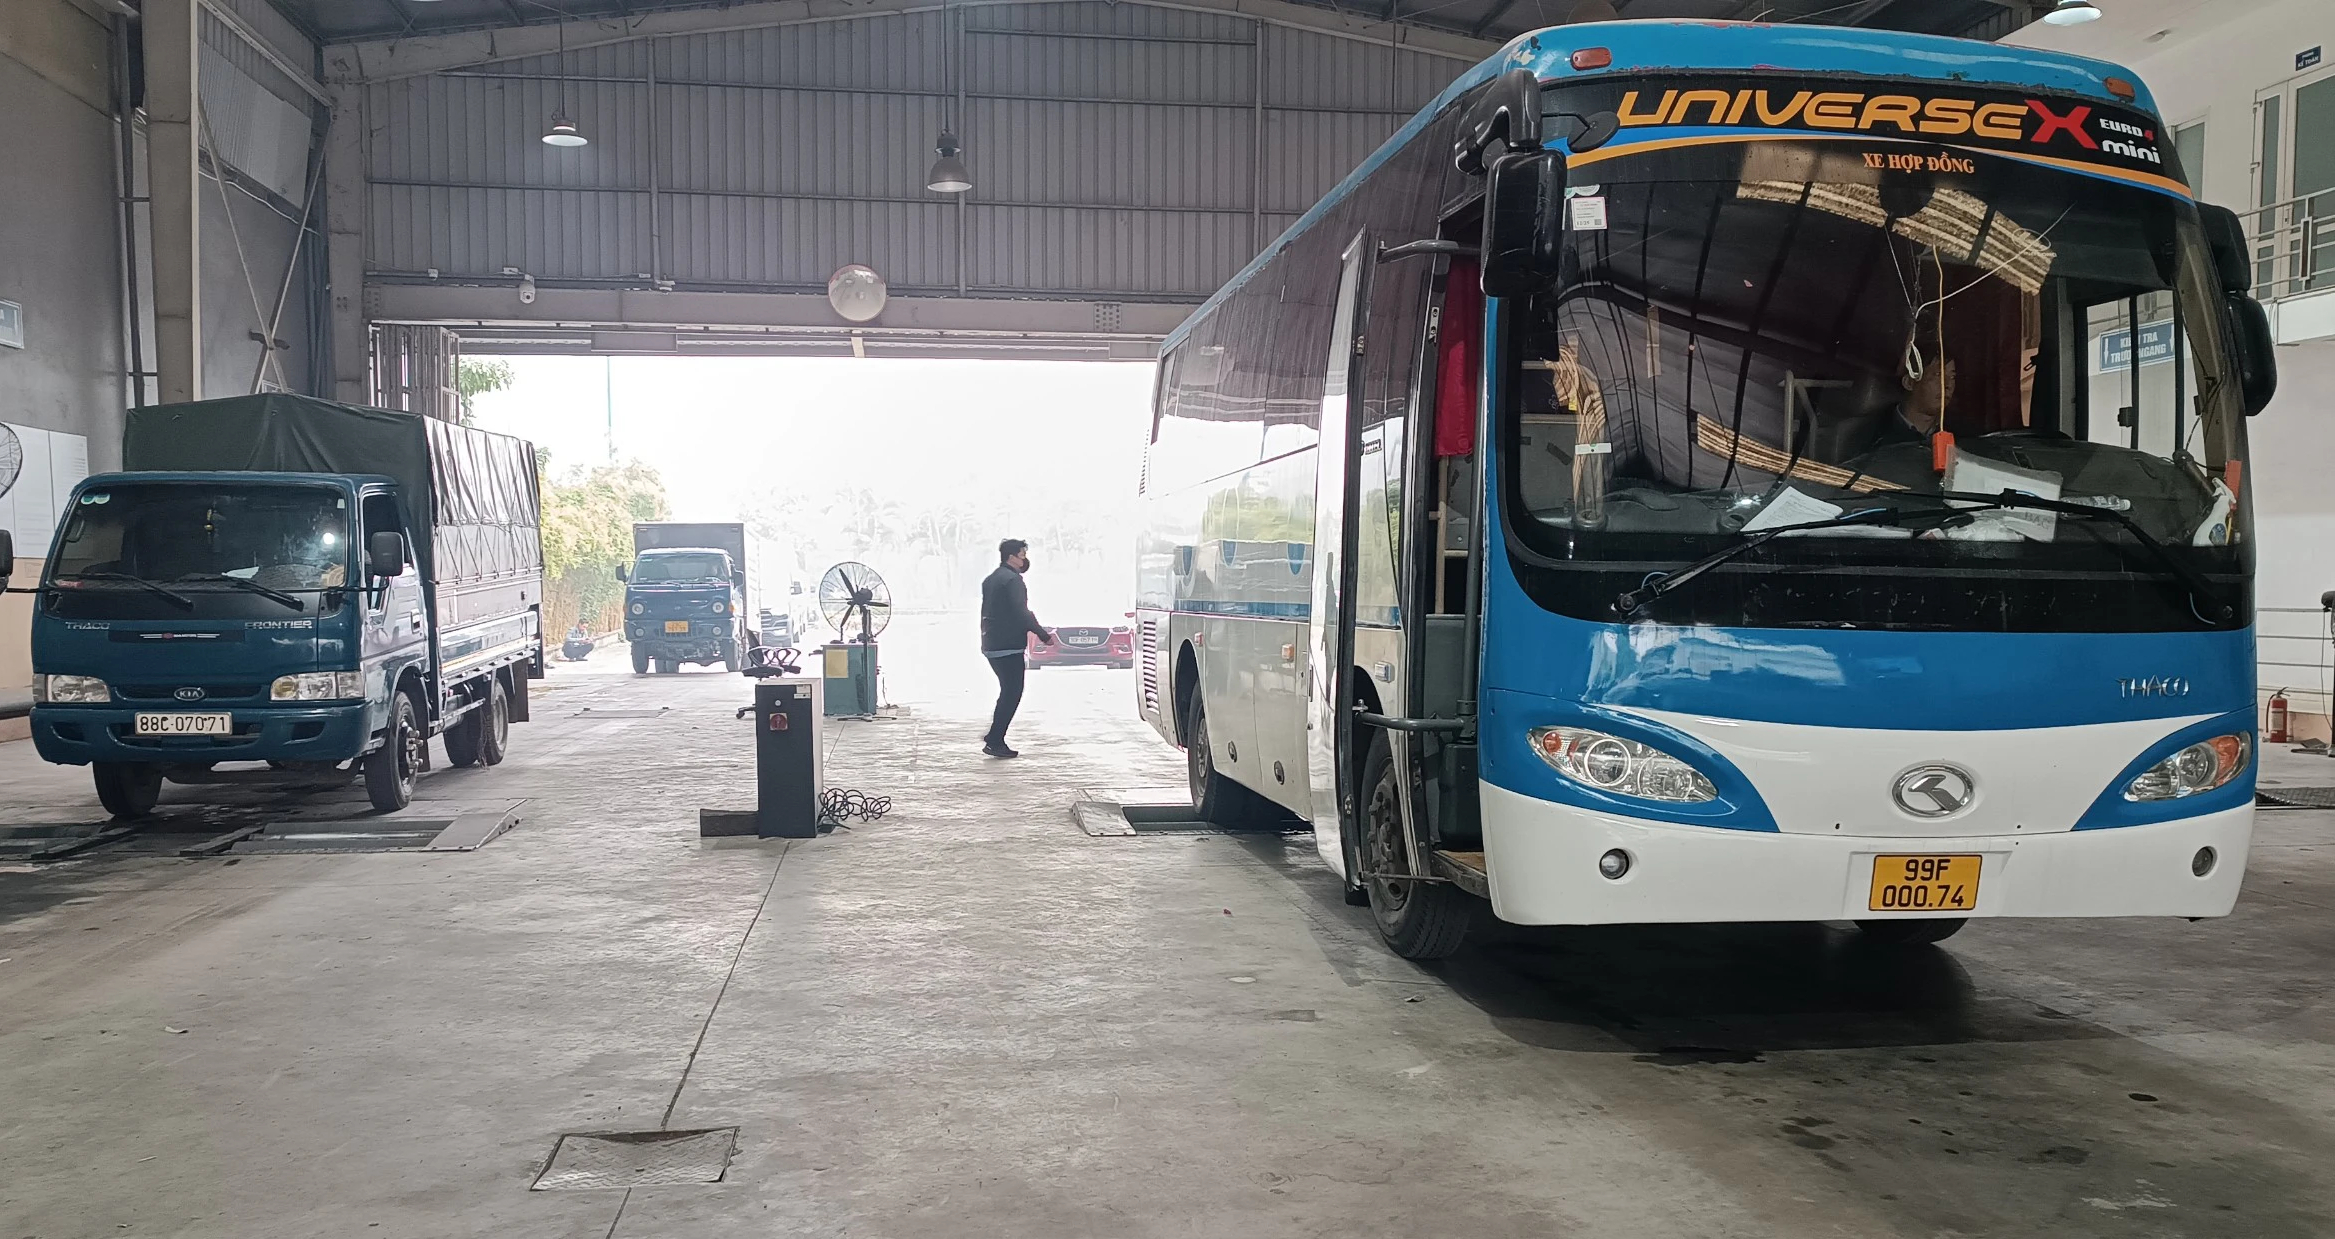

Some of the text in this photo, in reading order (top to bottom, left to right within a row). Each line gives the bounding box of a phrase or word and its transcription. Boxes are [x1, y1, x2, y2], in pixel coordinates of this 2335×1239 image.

[2102, 140, 2161, 164] mini
[1862, 151, 1975, 174] XE HỢP ĐỒNG
[2144, 332, 2158, 343] TRA
[2139, 344, 2166, 358] NGANG
[65, 621, 111, 630] THACO
[244, 620, 313, 629] FRONTIER
[179, 690, 200, 698] KIA
[2115, 675, 2189, 698] THACO
[1904, 858, 1951, 881] 99F
[1881, 884, 1965, 907] 000.74
